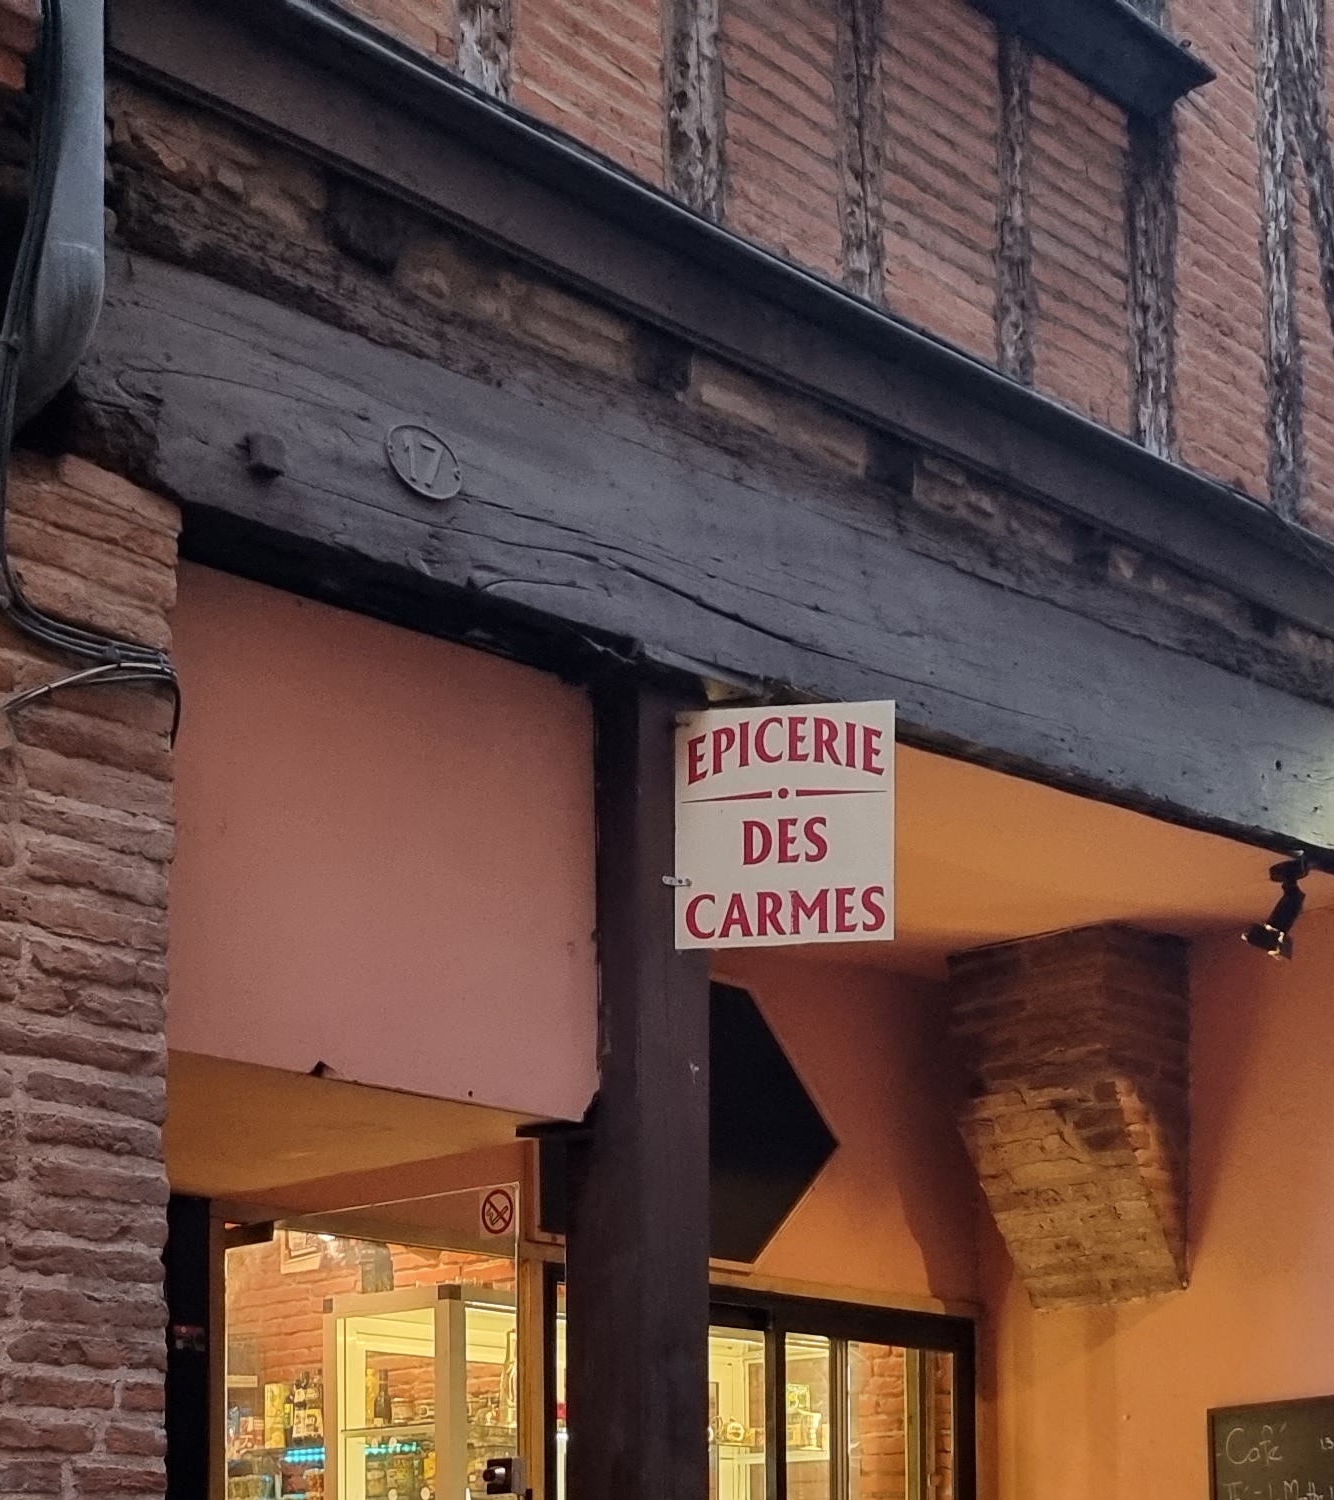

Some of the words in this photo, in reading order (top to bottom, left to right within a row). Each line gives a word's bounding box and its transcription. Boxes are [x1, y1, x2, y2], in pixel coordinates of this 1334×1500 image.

[401, 430, 444, 489] 17
[686, 716, 885, 786] EPICERIE
[742, 816, 828, 866] DES
[685, 886, 886, 939] CARMES
[1226, 1422, 1287, 1466] Café
